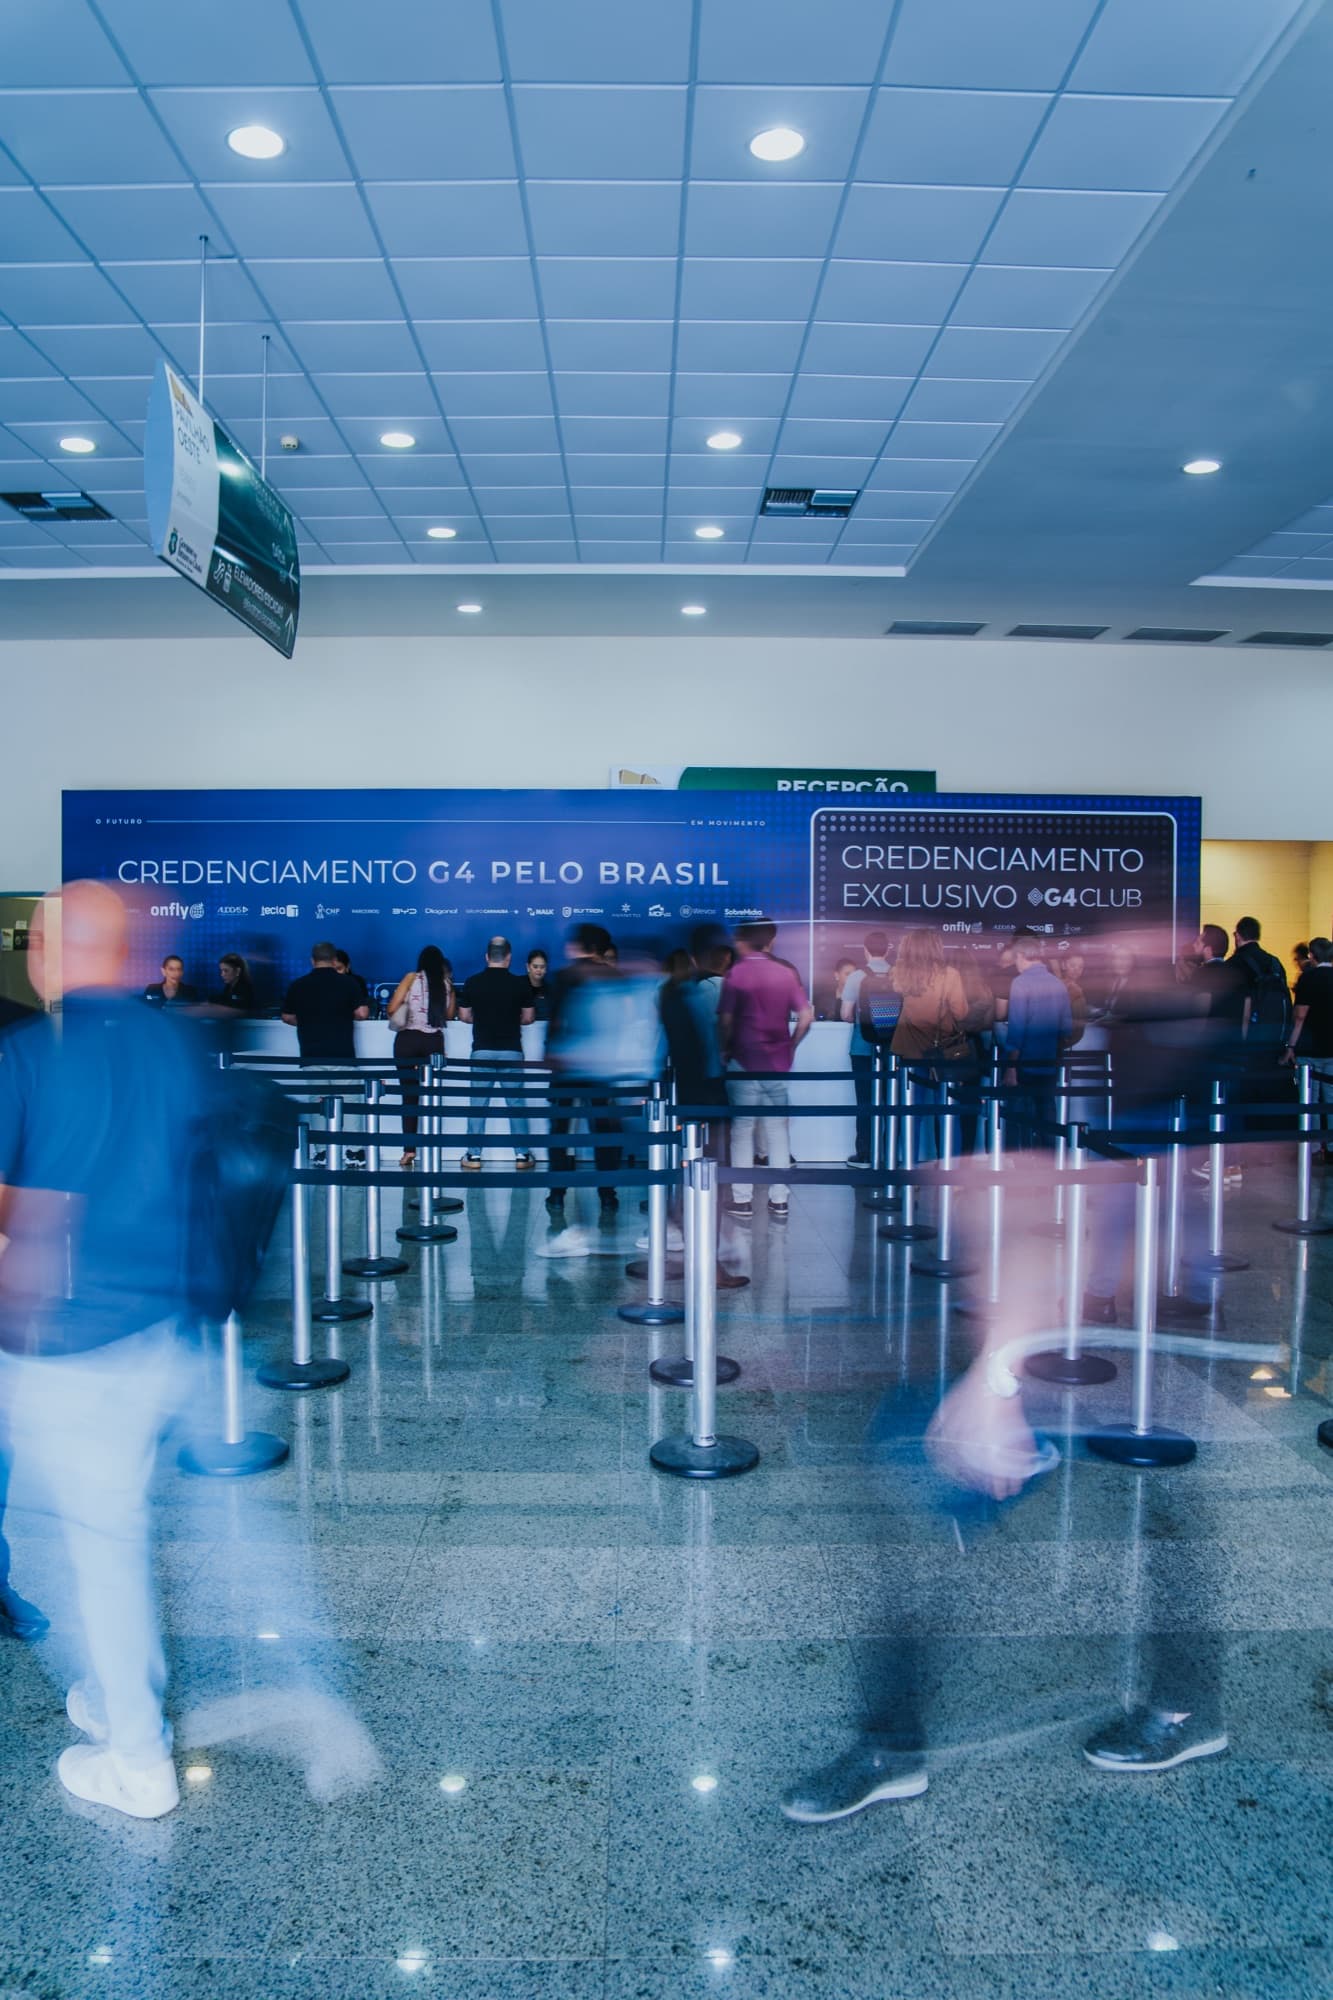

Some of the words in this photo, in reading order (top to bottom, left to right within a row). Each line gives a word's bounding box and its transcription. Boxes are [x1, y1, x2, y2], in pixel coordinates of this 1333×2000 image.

[177, 426, 201, 465] OESTE
[841, 845, 1144, 873] CREDENCIAMENTO
[117, 860, 417, 884] CREDENCIAMENTO
[428, 860, 476, 884] G4
[491, 861, 584, 884] PELO
[599, 862, 729, 886] BRASIL
[843, 883, 1017, 909] EXCLUSIVO
[150, 902, 188, 920] onfly
[942, 921, 971, 935] onfly
